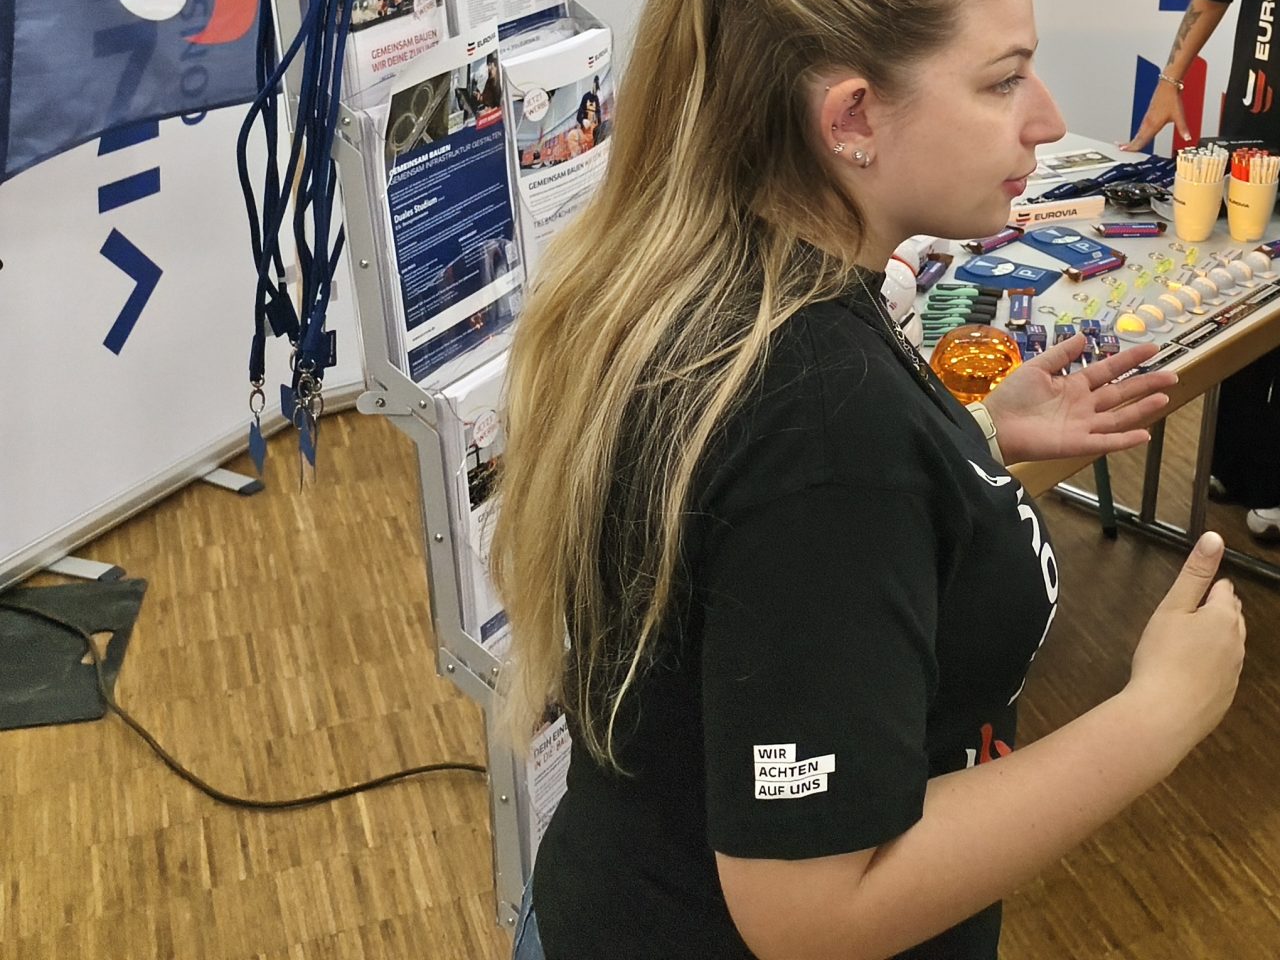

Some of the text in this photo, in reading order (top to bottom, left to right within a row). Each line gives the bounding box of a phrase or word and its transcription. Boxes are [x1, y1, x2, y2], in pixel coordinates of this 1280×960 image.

[372, 29, 438, 59] GEMEINSAM BAUEN
[372, 60, 388, 73] WIR
[388, 53, 409, 68] DEINE
[389, 144, 451, 177] GEMEINSAM BAUEN
[528, 162, 584, 190] GEMEINSAM BAUEN
[394, 197, 437, 224] Duales Studium
[1034, 208, 1078, 221] EUROVIA
[758, 748, 787, 759] WIR
[759, 760, 819, 778] ACHTEN
[758, 778, 821, 796] AUF UNS
